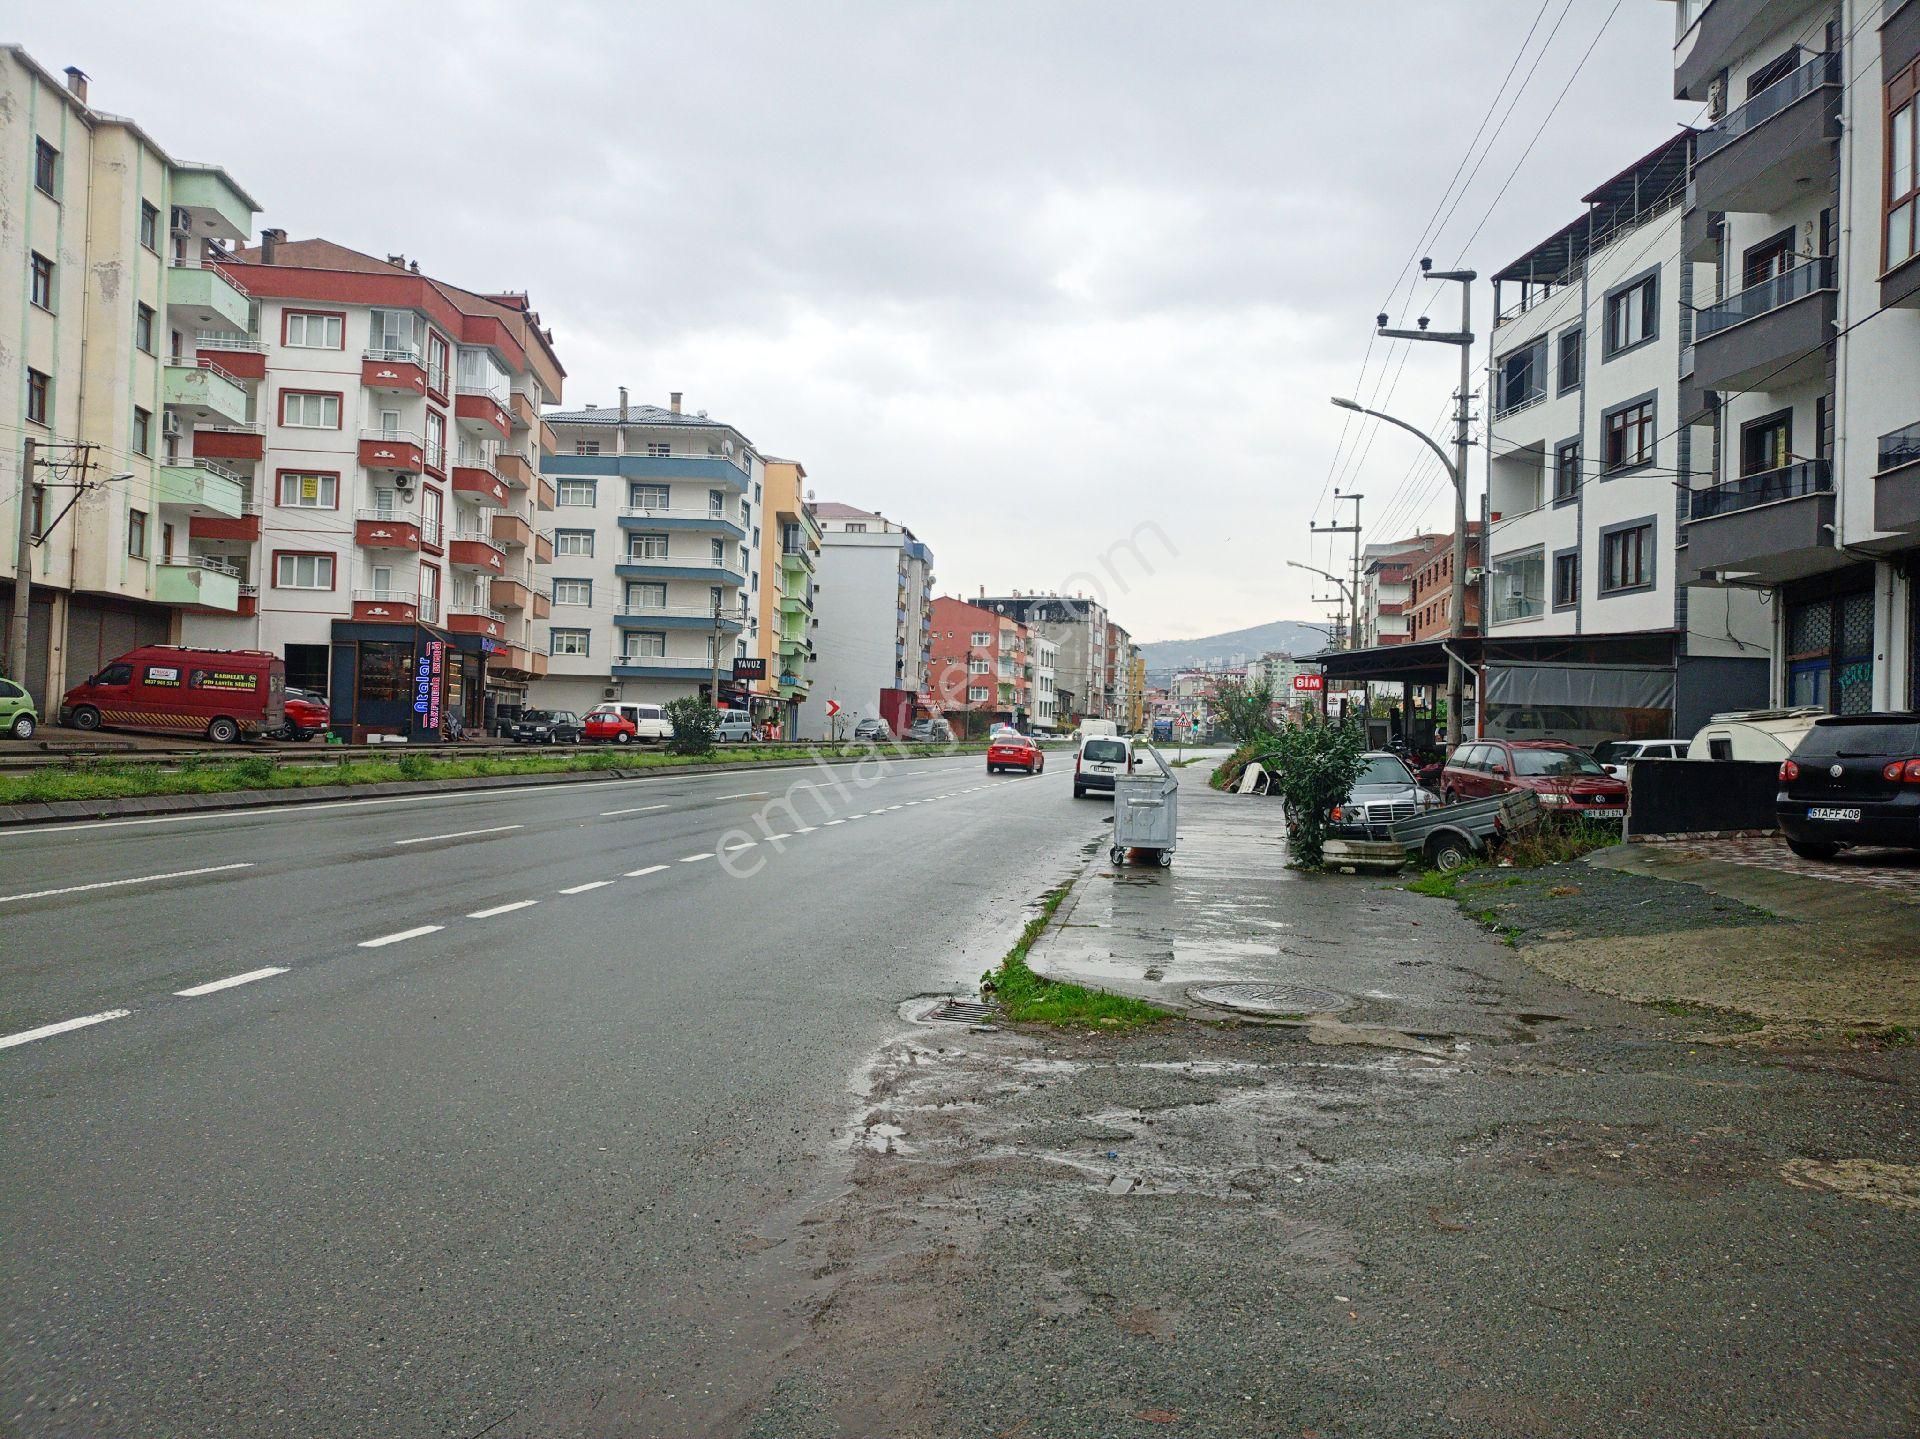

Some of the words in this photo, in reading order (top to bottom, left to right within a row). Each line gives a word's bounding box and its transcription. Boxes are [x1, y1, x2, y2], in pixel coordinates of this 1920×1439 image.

[738, 659, 761, 669] YAVUZ
[414, 657, 430, 713] Atalar
[1296, 676, 1320, 688] BİM
